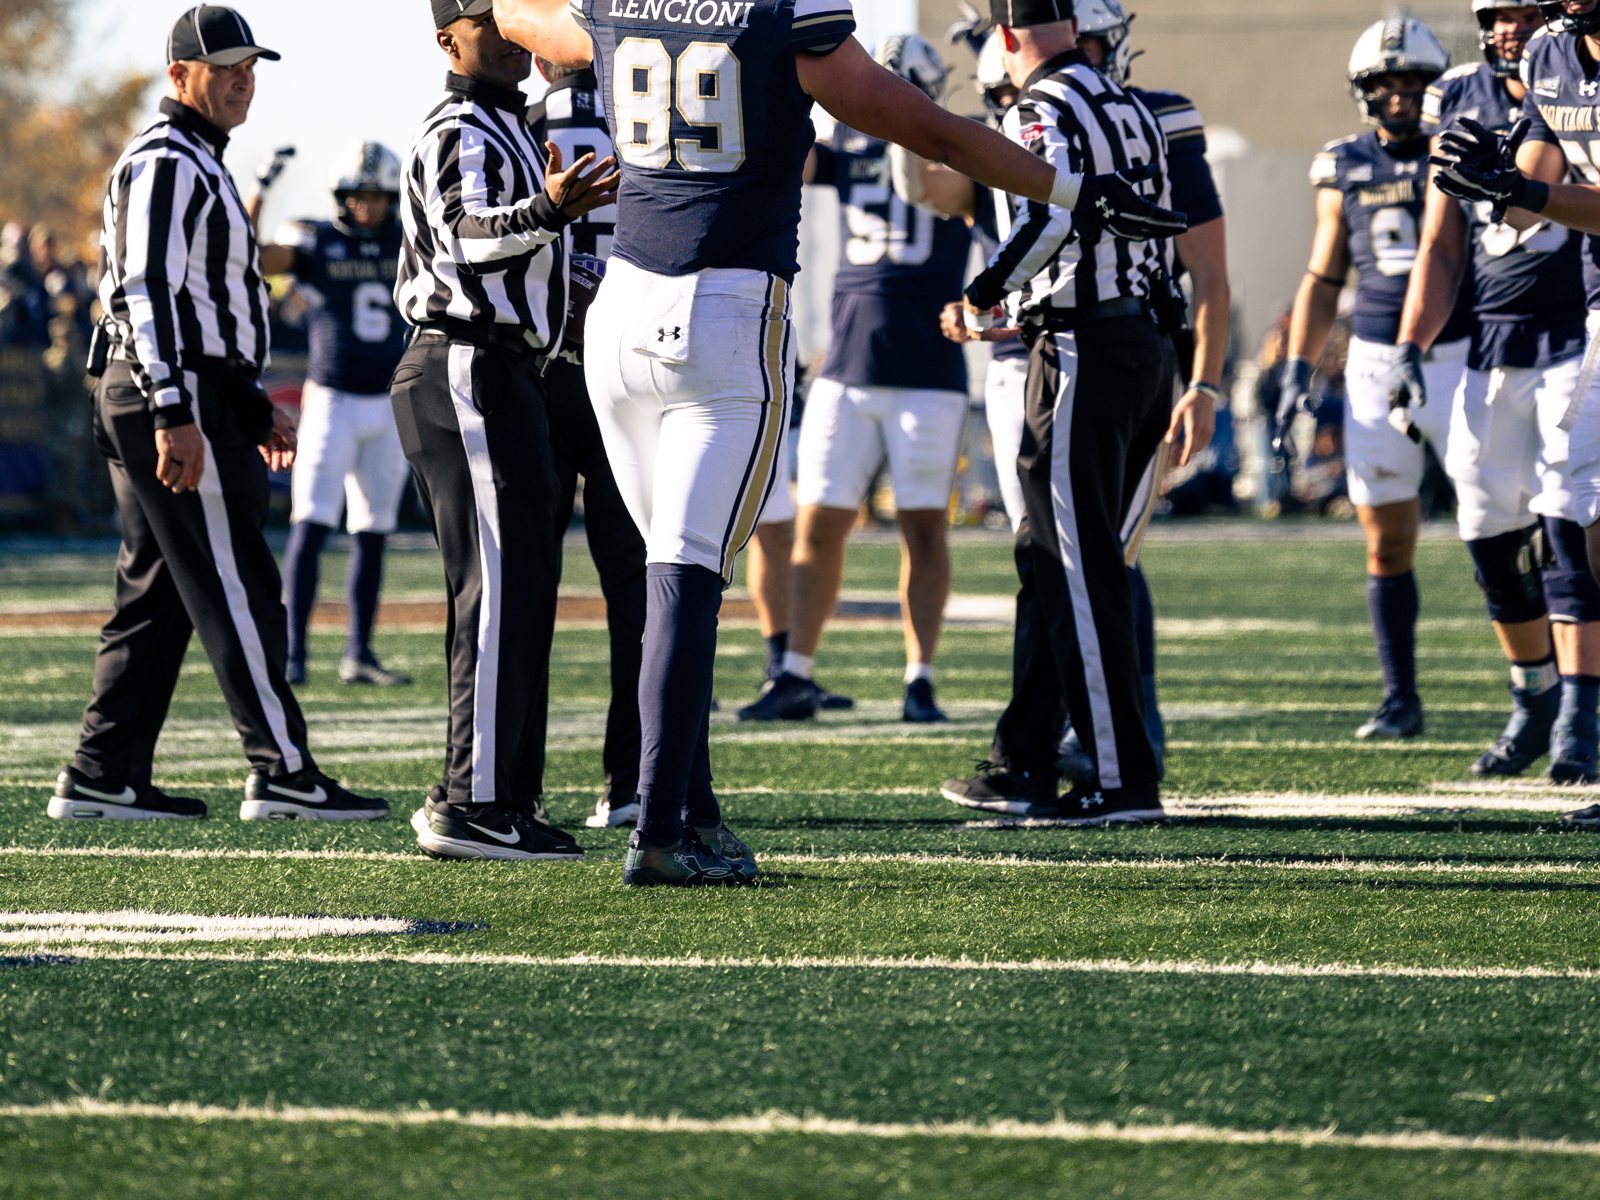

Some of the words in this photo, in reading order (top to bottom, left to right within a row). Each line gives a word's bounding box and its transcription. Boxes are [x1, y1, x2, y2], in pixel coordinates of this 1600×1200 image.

[613, 36, 747, 173] 89
[845, 184, 934, 266] 50
[352, 281, 392, 343] 6
